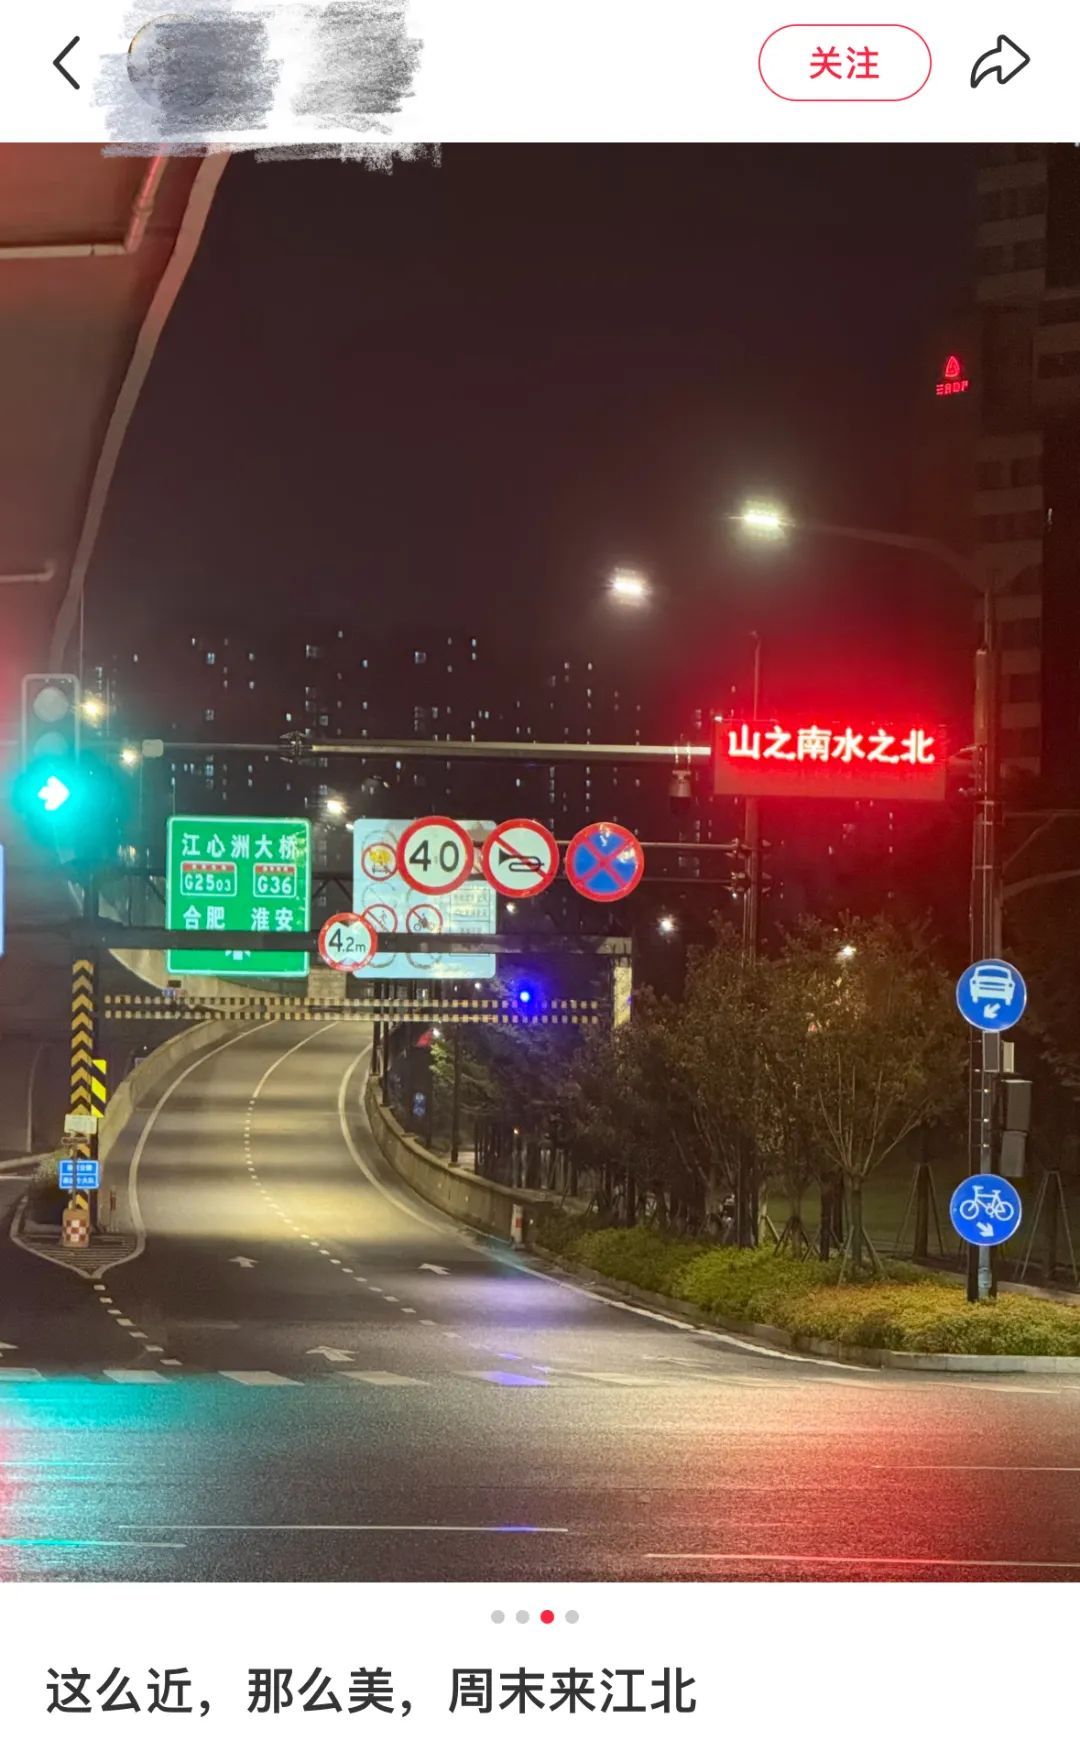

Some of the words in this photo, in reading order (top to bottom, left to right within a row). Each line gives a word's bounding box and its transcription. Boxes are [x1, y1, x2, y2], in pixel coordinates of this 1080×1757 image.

[728, 724, 935, 765] 山之南水之北
[181, 832, 297, 860] 江心洲大桥
[408, 839, 460, 874] 40
[184, 873, 232, 892] G2503
[257, 876, 292, 894] G36
[182, 904, 225, 930] 合肥
[250, 907, 294, 932] 淮安
[327, 927, 367, 953] 4.2m
